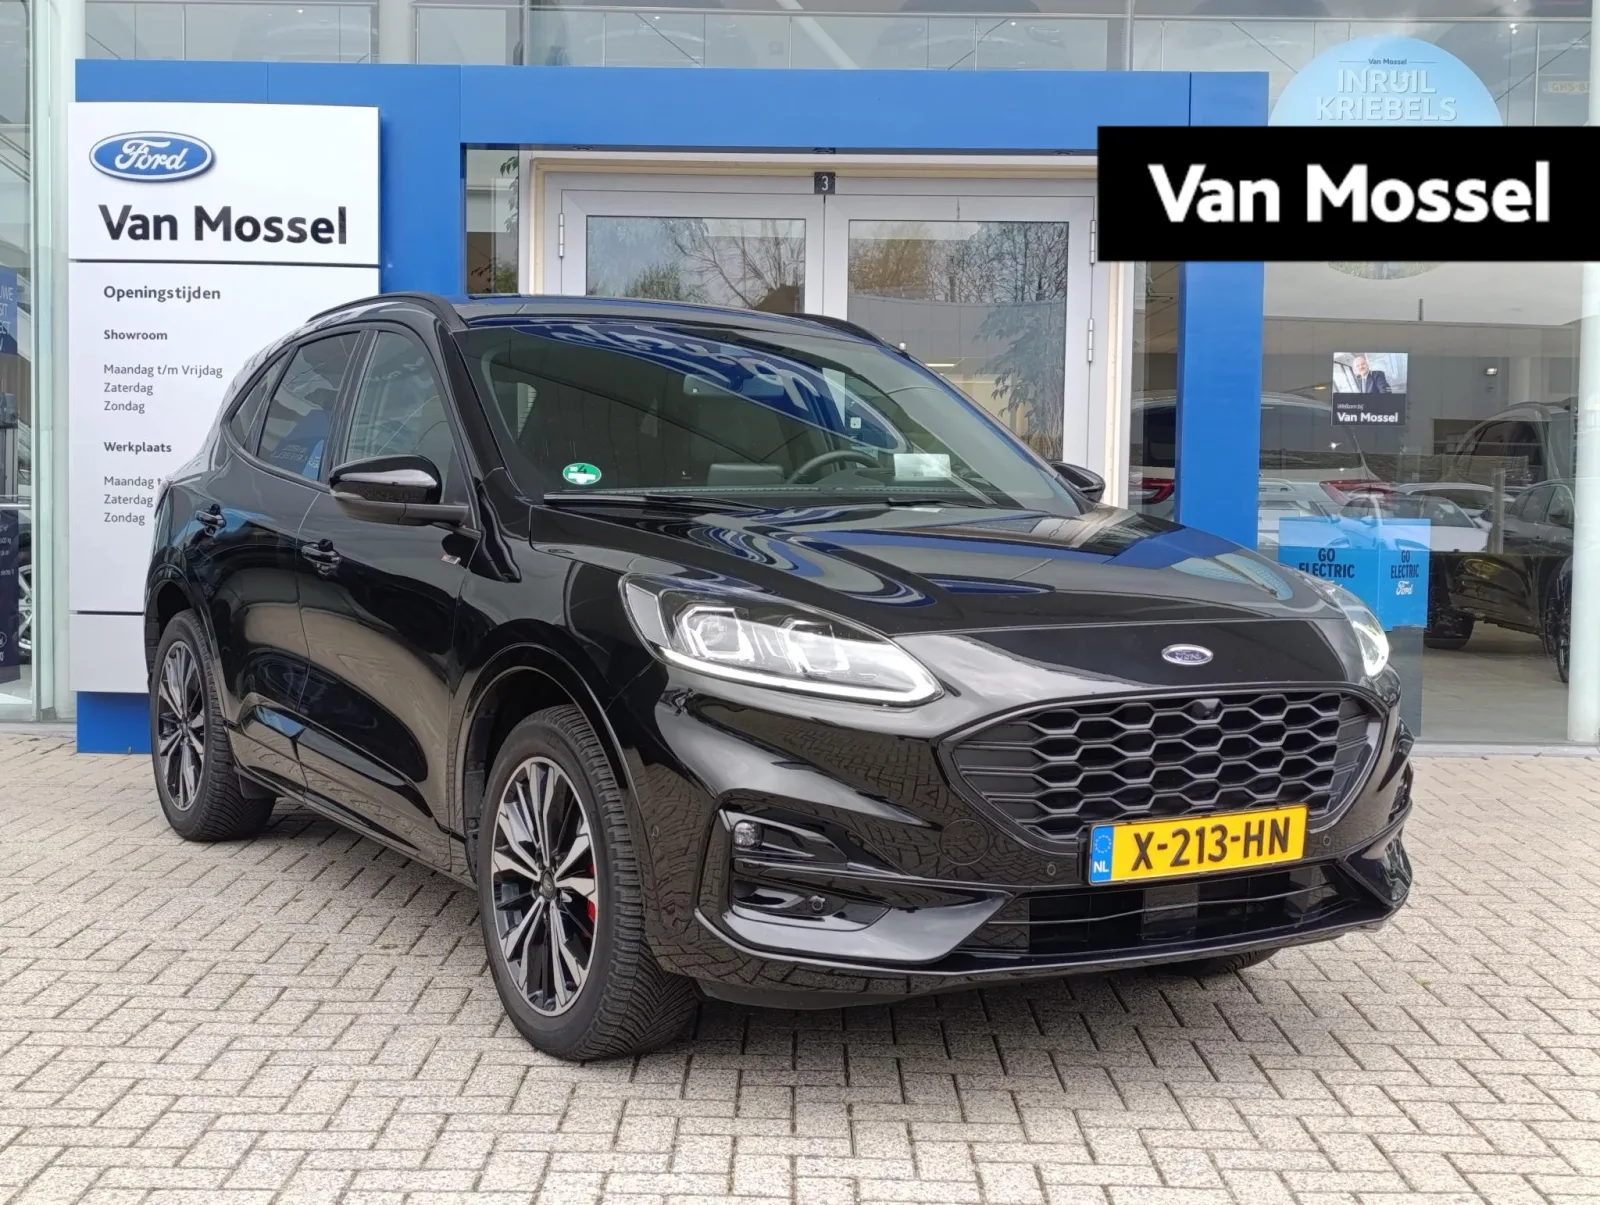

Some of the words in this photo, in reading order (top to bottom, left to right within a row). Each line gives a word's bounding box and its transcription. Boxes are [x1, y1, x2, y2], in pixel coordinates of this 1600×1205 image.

[1338, 69, 1437, 94] INRUIL
[1316, 96, 1457, 121] KRIEBELS
[114, 139, 188, 171] Ford
[821, 175, 829, 191] 3
[98, 204, 179, 240] Van
[194, 205, 347, 244] Mossel
[103, 285, 221, 303] Openingstijden
[103, 329, 168, 340] Showroom
[103, 364, 154, 377] Maandag
[157, 364, 178, 375] t/m
[181, 365, 223, 378] Vrijdag
[103, 382, 154, 396] Zaterdag
[103, 400, 146, 414] Zondag
[1337, 412, 1357, 422] Van
[1360, 412, 1399, 422] Mossel
[103, 441, 172, 455] Werkplaats
[103, 476, 154, 489] Maandag
[103, 494, 154, 508] Zaterdag
[103, 512, 146, 526] Zondag
[1318, 548, 1335, 562] GO
[1401, 550, 1411, 563] GO
[1390, 563, 1420, 579] ELECTRIC
[1396, 580, 1414, 596] Ford
[1131, 816, 1291, 871] X-213-HN
[1093, 860, 1110, 873] NL
